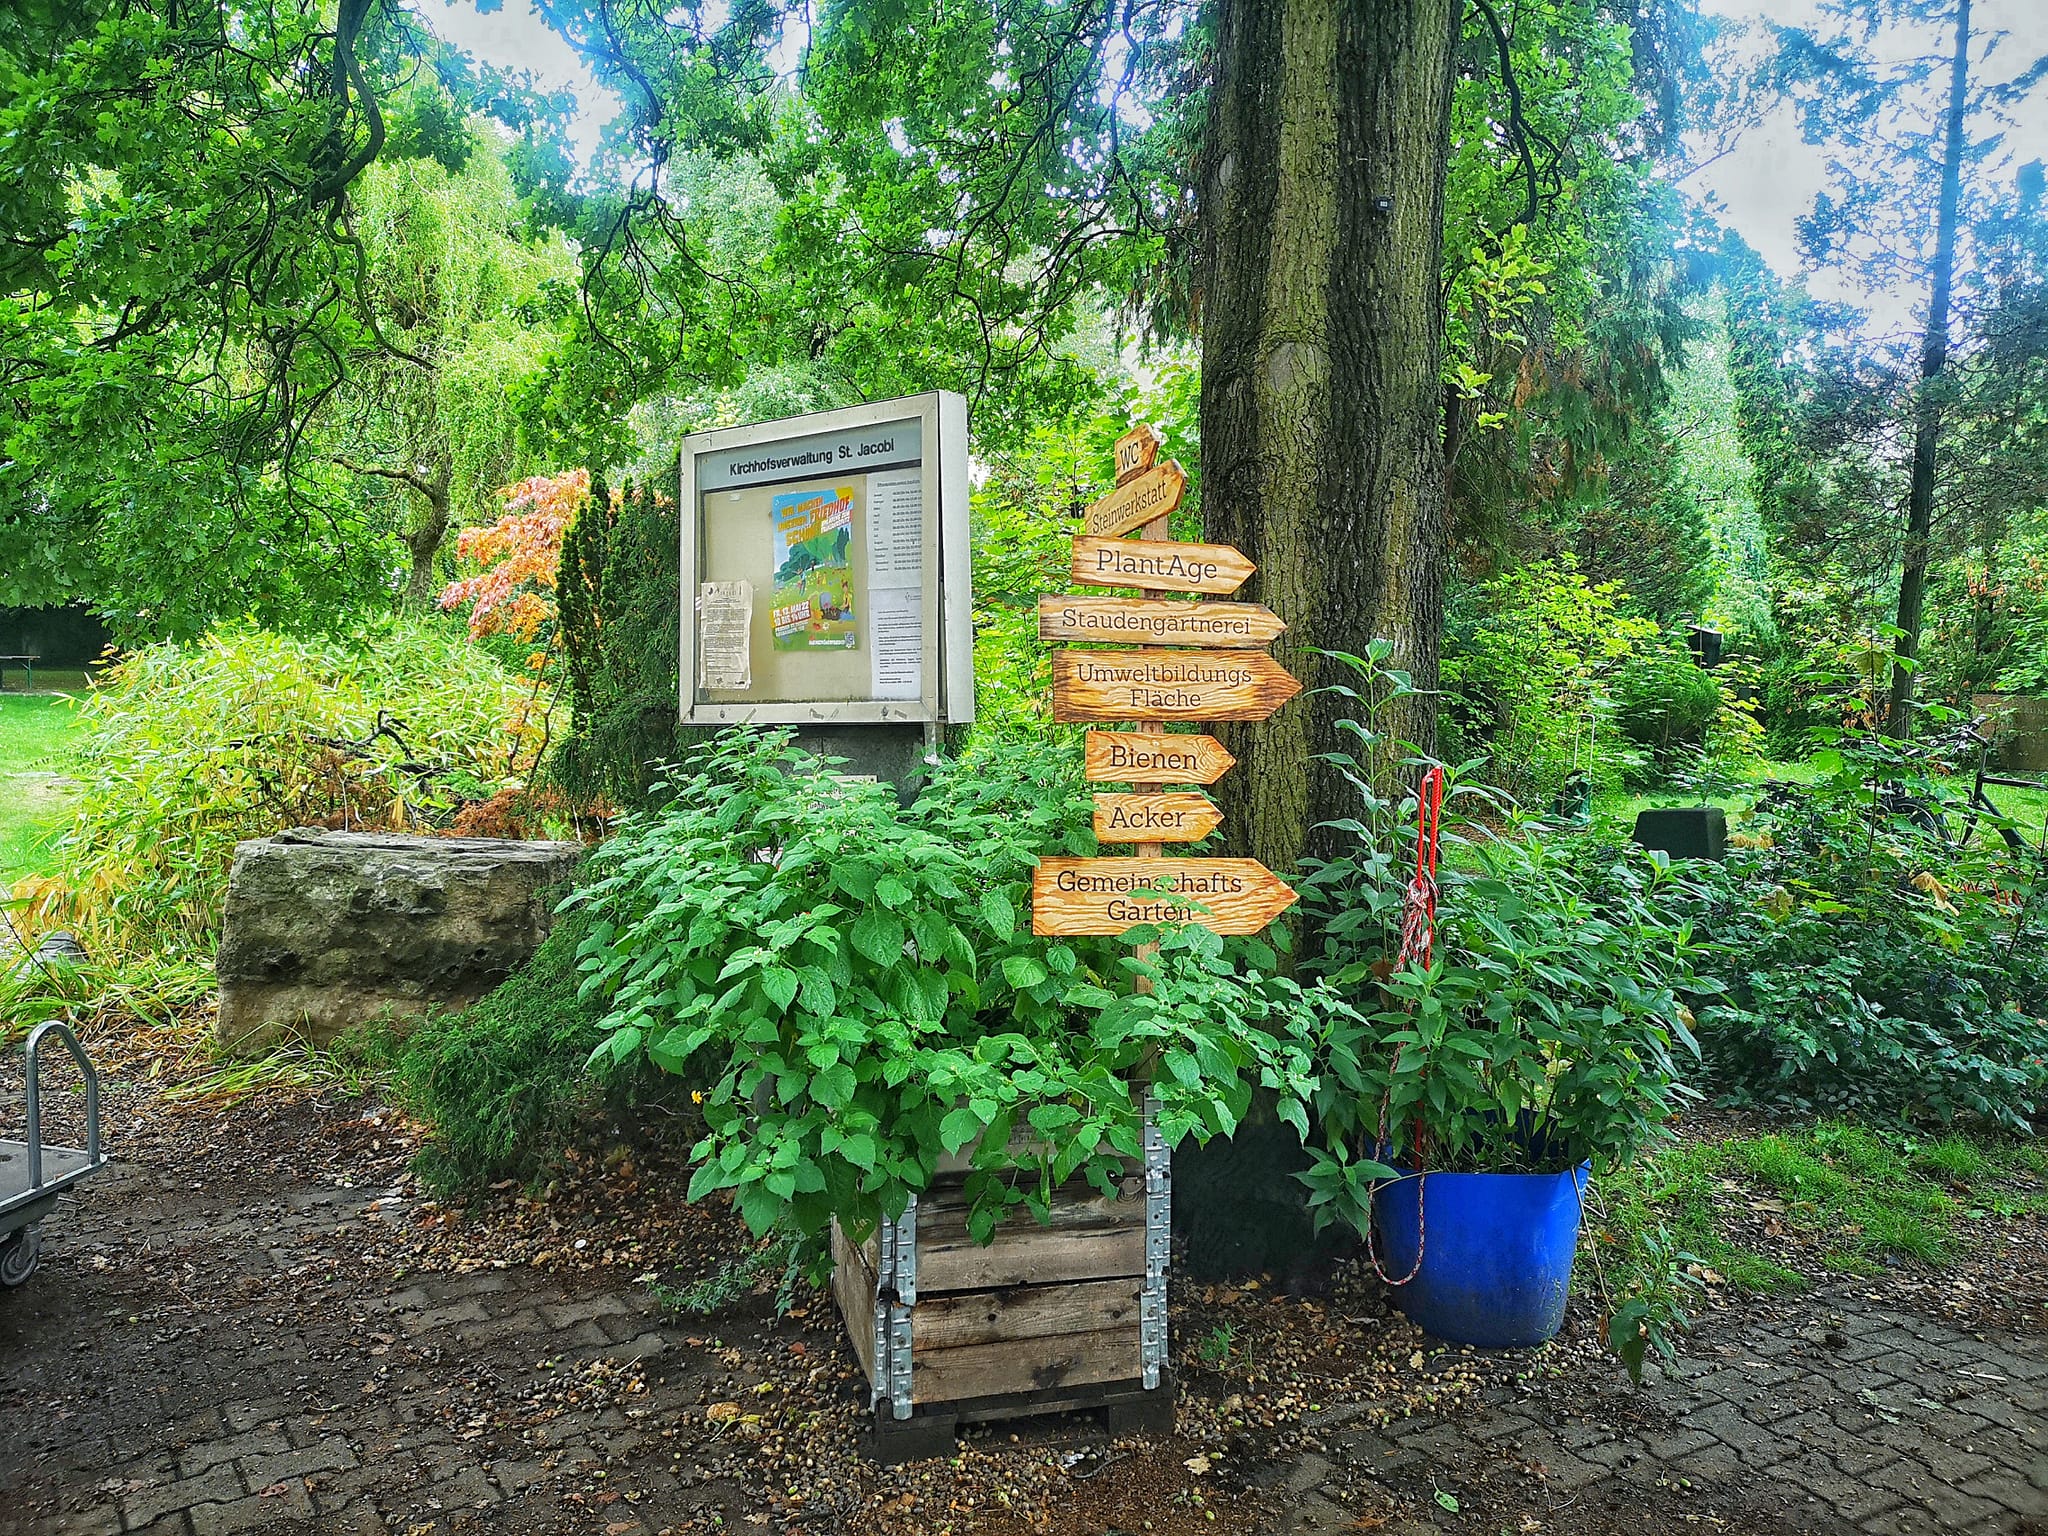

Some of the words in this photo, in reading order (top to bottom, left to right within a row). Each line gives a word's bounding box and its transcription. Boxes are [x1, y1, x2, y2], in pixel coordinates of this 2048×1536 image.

[730, 451, 833, 476] Kirchhofsverwaltung
[838, 445, 853, 459] St.
[857, 438, 895, 457] Jacobi
[1120, 442, 1139, 472] WC
[809, 496, 850, 523] FRIEDHOF
[1092, 481, 1168, 534] Steinwerkstatt
[1096, 549, 1218, 584] PlantAge
[1062, 608, 1251, 636] Staudengärtnerei
[1077, 663, 1252, 686] Umweltbildungs
[1130, 689, 1201, 707] Fläche
[1109, 745, 1198, 770] Bienen
[1108, 807, 1187, 829] Acker
[1107, 900, 1193, 921] Garten
